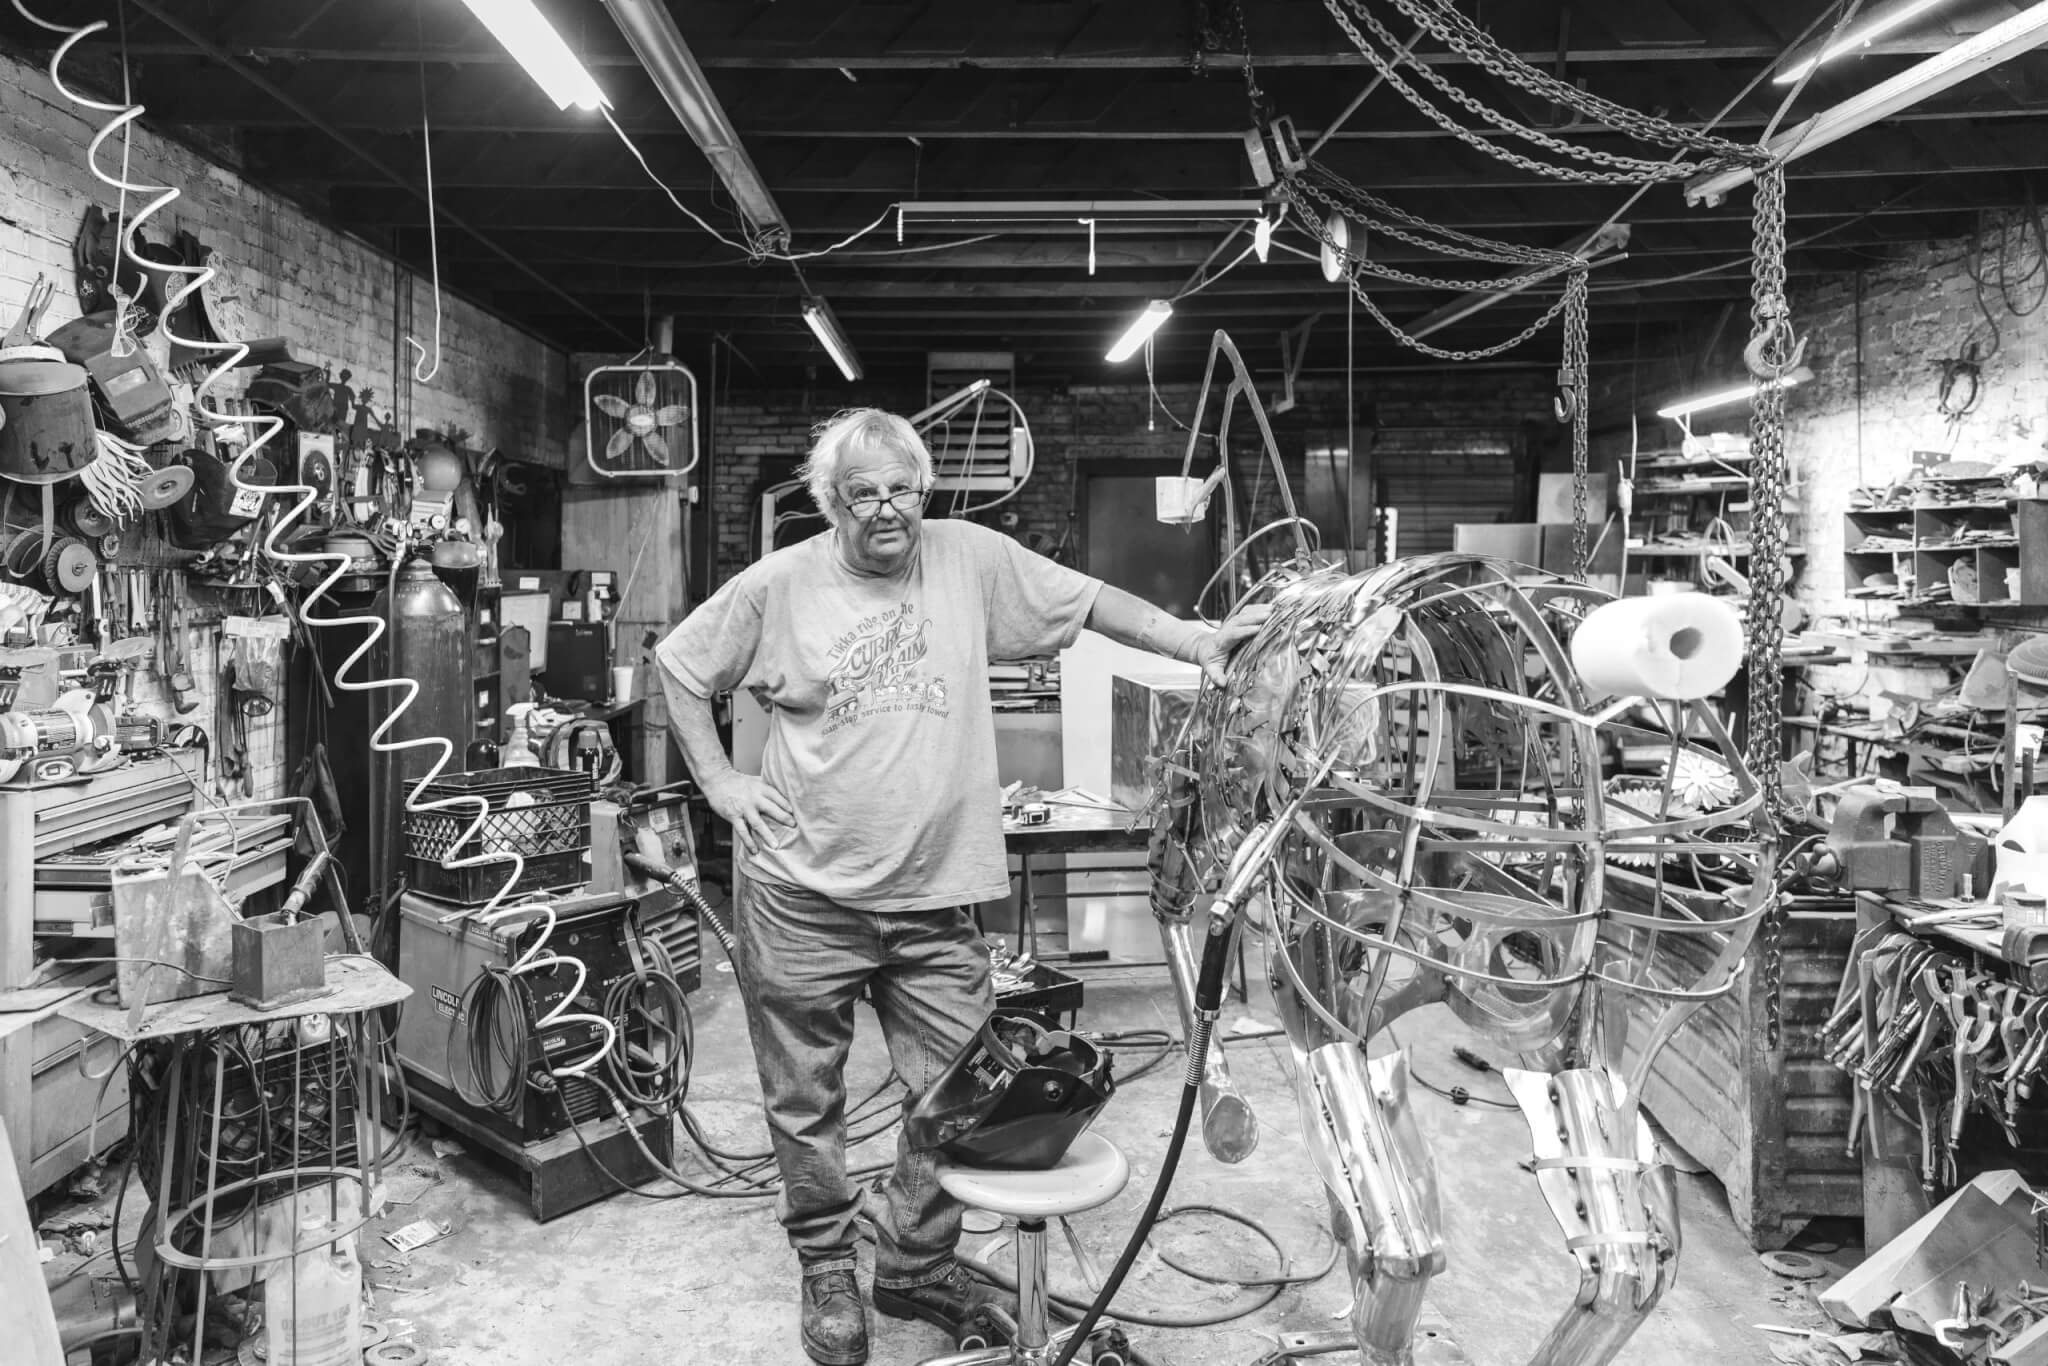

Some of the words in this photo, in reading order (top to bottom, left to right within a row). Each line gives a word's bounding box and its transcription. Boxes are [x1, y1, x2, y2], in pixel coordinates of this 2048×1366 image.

[826, 630, 858, 661] Tikka
[857, 615, 878, 635] ride
[881, 609, 897, 623] on
[851, 621, 904, 672] CURRY
[875, 628, 929, 684] TRAIN
[860, 706, 891, 719] service
[894, 703, 903, 713] to
